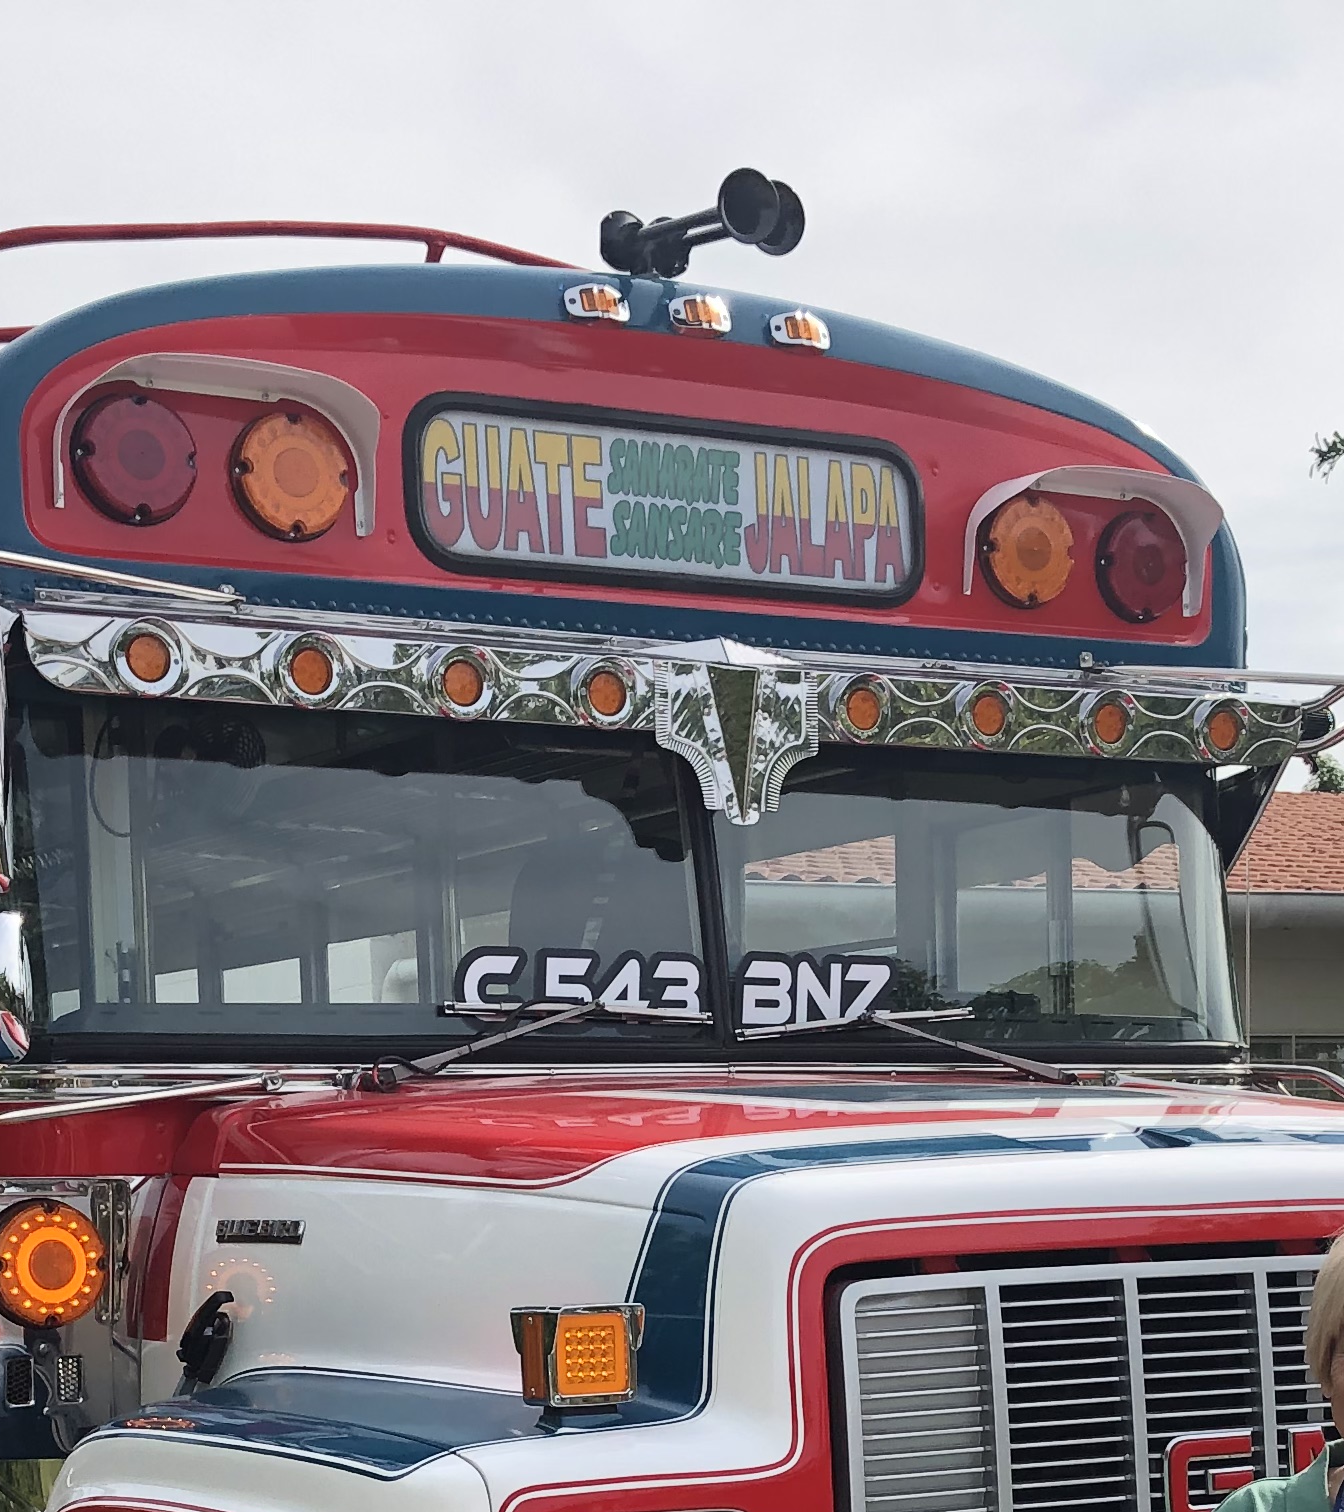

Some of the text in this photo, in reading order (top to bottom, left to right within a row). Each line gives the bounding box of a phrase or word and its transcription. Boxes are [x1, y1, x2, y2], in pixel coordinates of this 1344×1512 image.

[422, 418, 608, 558] GUATE
[607, 438, 741, 506] SANARATE
[609, 500, 742, 569] SANSARE
[745, 451, 906, 588] JALAPA
[463, 955, 892, 1025] C 543 BNZ
